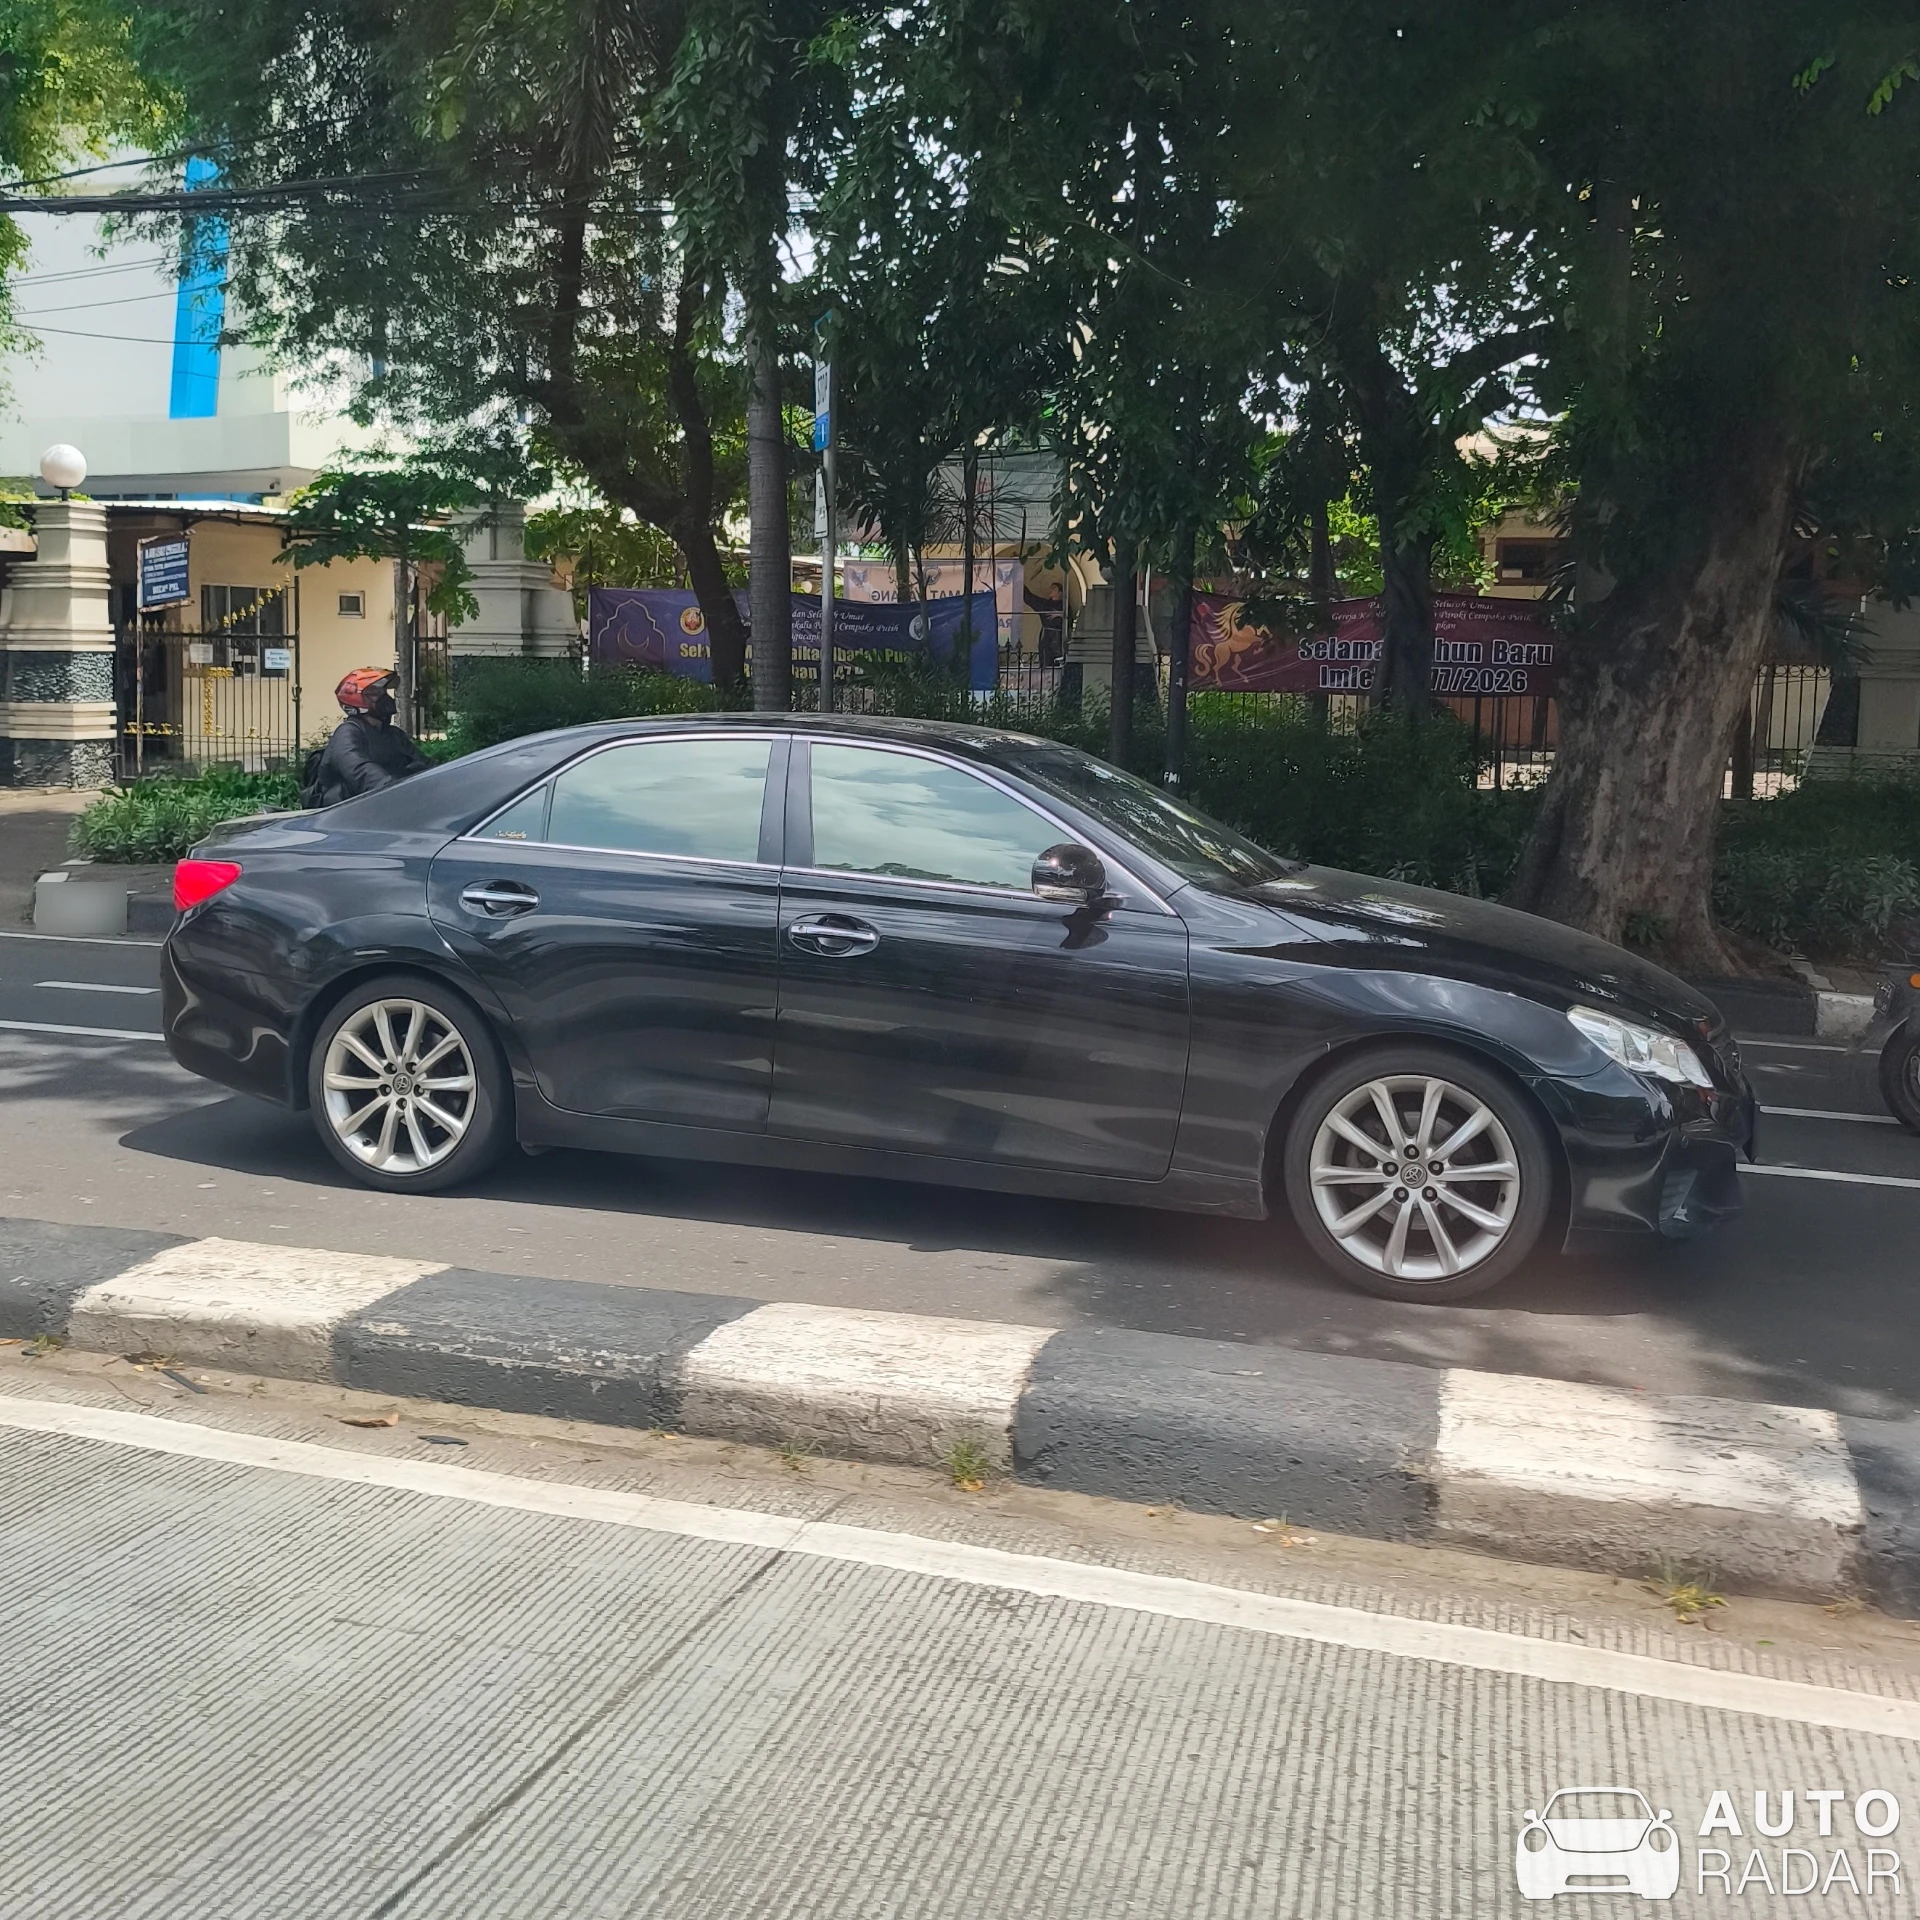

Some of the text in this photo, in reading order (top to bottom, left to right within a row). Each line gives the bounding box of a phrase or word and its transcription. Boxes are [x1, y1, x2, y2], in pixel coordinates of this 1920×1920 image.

[1298, 637, 1554, 666] Selama hun Baru
[1319, 664, 1376, 690] Imle
